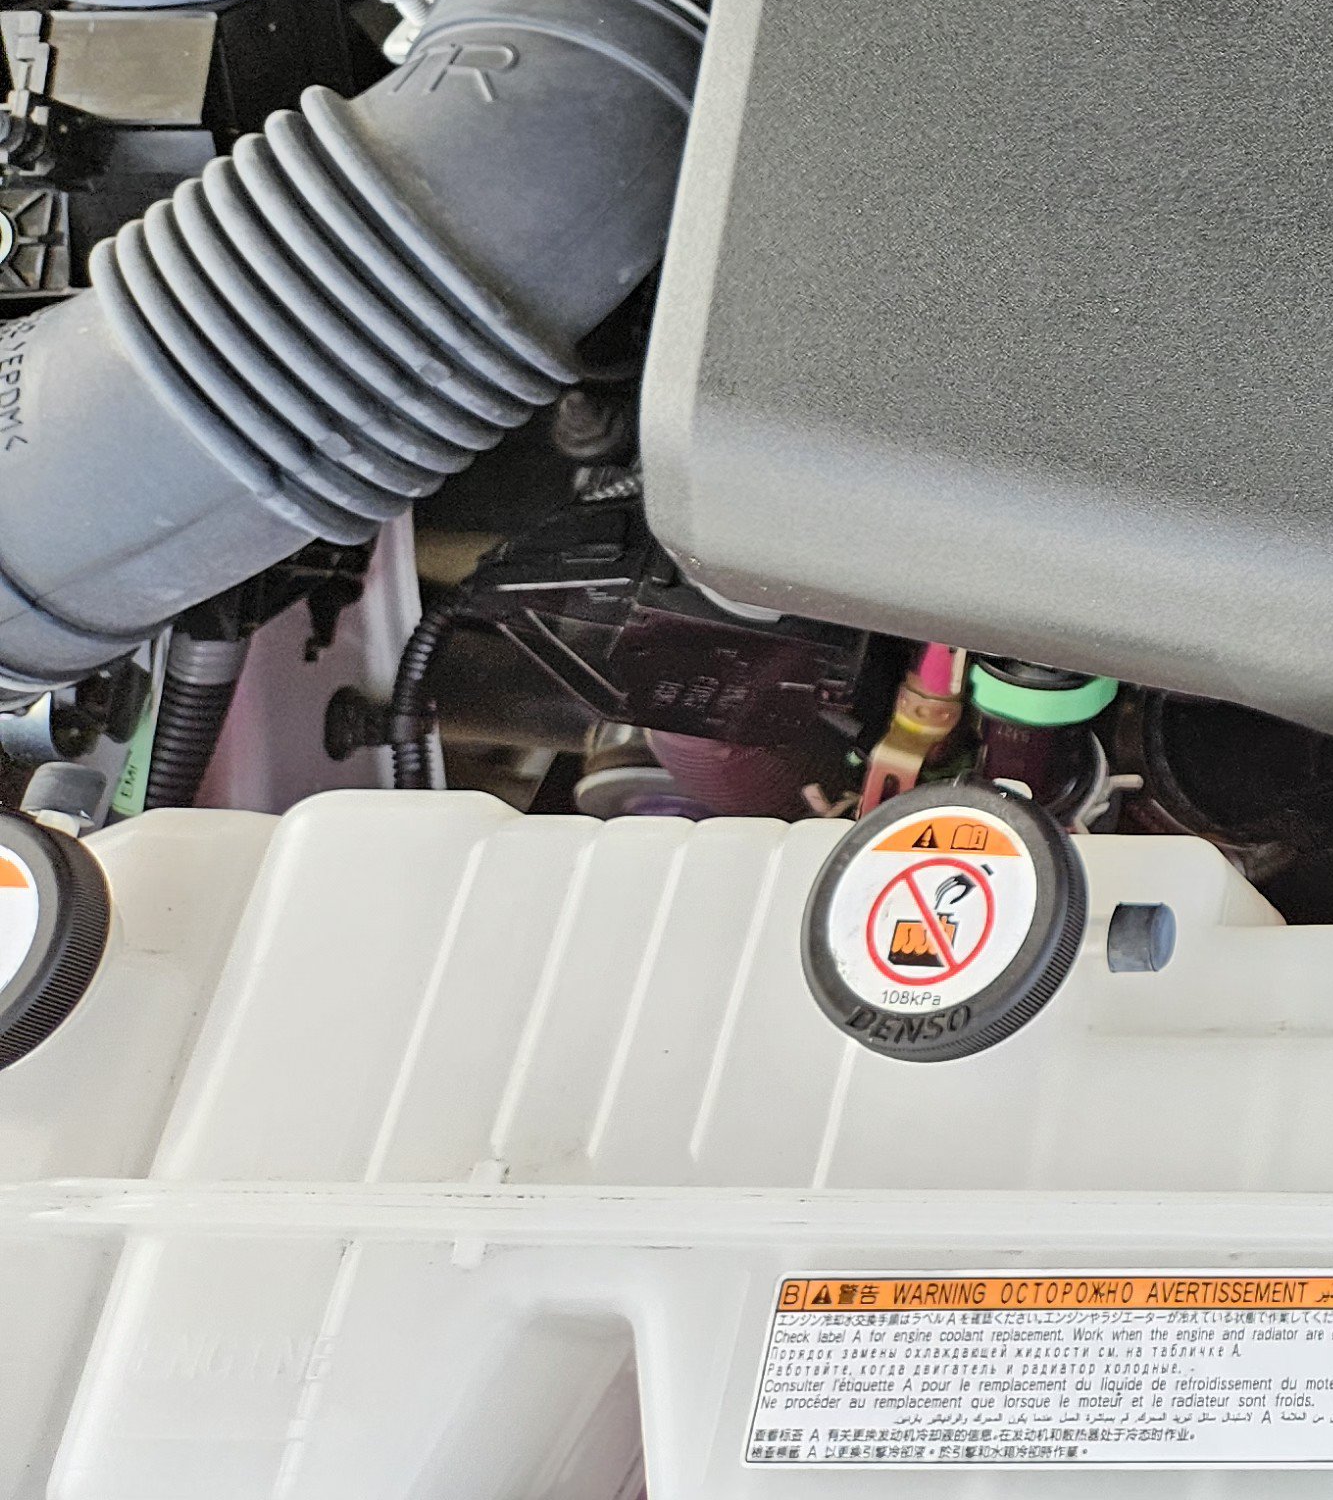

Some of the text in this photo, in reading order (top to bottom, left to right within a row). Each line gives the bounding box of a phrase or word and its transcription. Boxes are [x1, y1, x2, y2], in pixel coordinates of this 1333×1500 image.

[881, 989, 942, 1006] 108kPa
[845, 1004, 971, 1044] DENSO
[783, 1284, 800, 1305] B
[837, 1284, 880, 1305] 警告
[893, 1282, 987, 1305] WARNING
[1000, 1282, 1134, 1304] ОСТОРОЖНО
[1146, 1281, 1309, 1303] AVERTISSEMENT
[774, 1330, 810, 1344] Check
[817, 1330, 845, 1344] label
[868, 1330, 886, 1344] for
[893, 1331, 932, 1344] engine
[940, 1329, 984, 1343] coolant
[991, 1329, 1064, 1343] replacement.
[1073, 1329, 1103, 1343] Work
[1112, 1329, 1143, 1343] when
[1151, 1329, 1169, 1343] the
[1176, 1331, 1216, 1345] engine
[1222, 1328, 1245, 1342] and
[1252, 1328, 1298, 1342] radiator
[1306, 1331, 1325, 1342] are
[770, 1347, 832, 1361] Порядок
[841, 1348, 897, 1359] замены
[1015, 1347, 1089, 1360] жидкости
[1126, 1347, 1143, 1359] на
[1152, 1344, 1224, 1359] табличке
[860, 1364, 906, 1376] когда
[913, 1364, 997, 1376] двигатель
[1022, 1364, 1096, 1376] радиатор
[764, 1379, 825, 1393] Consulter
[920, 1381, 952, 1393] pour
[959, 1378, 971, 1392] le
[978, 1378, 1067, 1393] remplacement
[1075, 1378, 1092, 1392] du
[1100, 1378, 1143, 1393] liquide
[1151, 1378, 1167, 1392] de
[1175, 1377, 1273, 1391] refroidissement
[1281, 1377, 1297, 1391] du
[760, 1394, 1315, 1410] Ne procéder au remplacement que lorsque le moteur et le radiateur sont froids.
